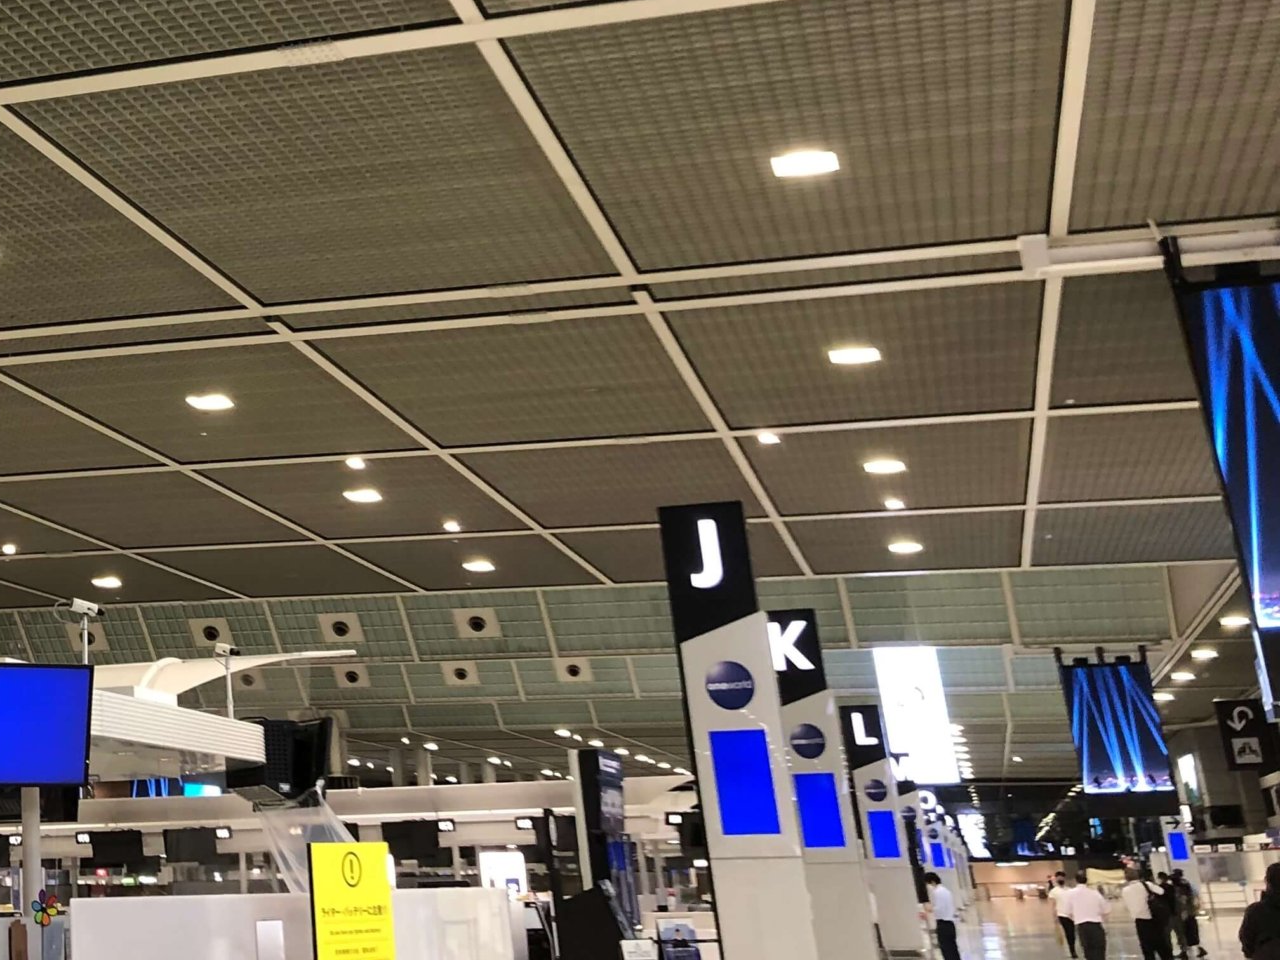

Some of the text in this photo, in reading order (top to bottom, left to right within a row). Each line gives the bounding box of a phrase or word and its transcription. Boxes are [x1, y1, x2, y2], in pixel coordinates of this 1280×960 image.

[690, 519, 723, 588] J
[766, 620, 816, 671] K
[850, 712, 879, 745] L
